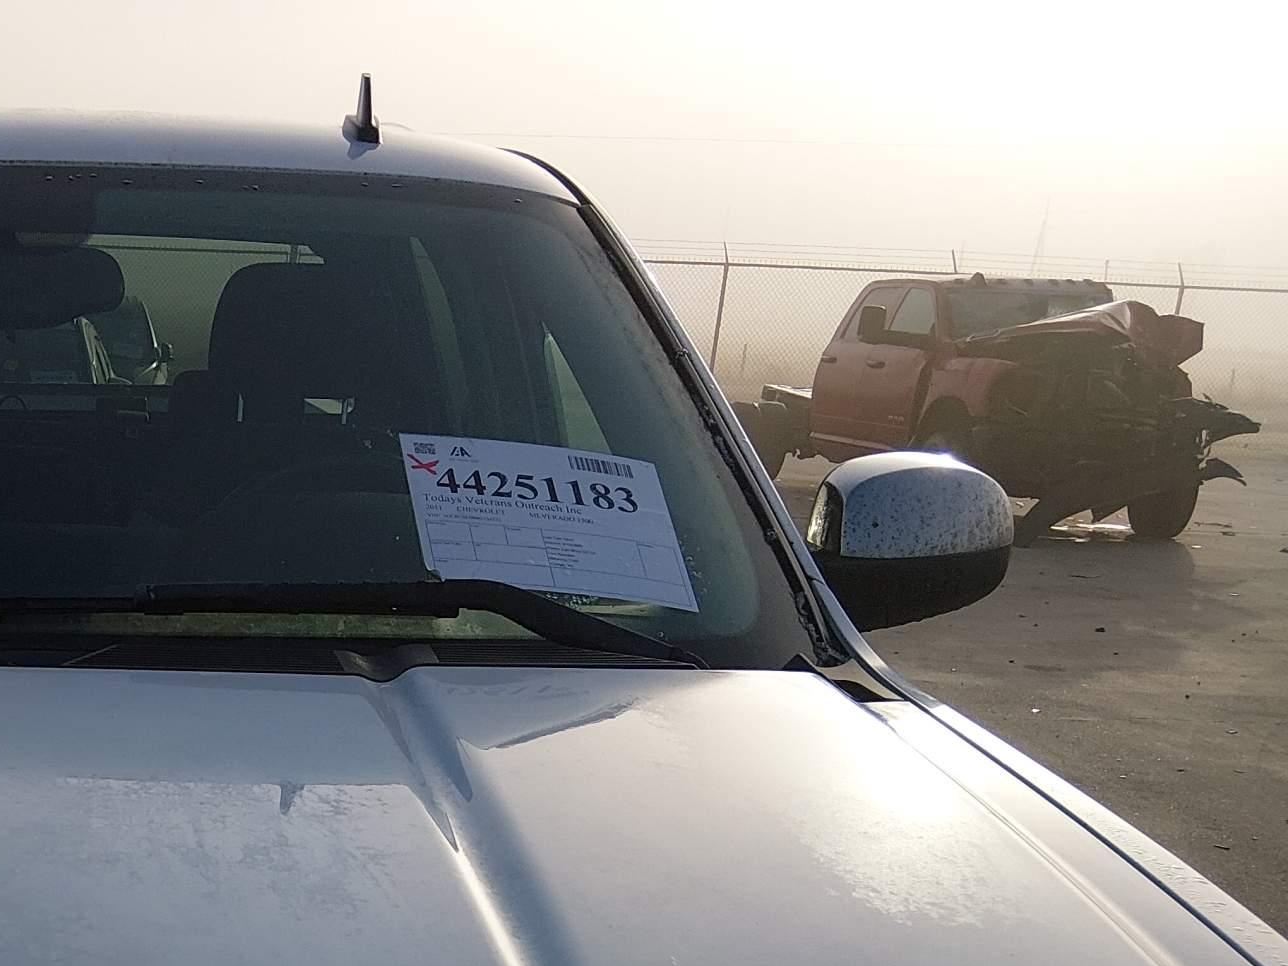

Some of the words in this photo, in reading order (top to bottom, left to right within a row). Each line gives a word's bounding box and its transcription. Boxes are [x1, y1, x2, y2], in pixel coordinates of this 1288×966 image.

[423, 493, 462, 504] Todays
[464, 496, 513, 508] Veterans
[514, 500, 564, 513] Outreach
[436, 468, 639, 514] 44251183
